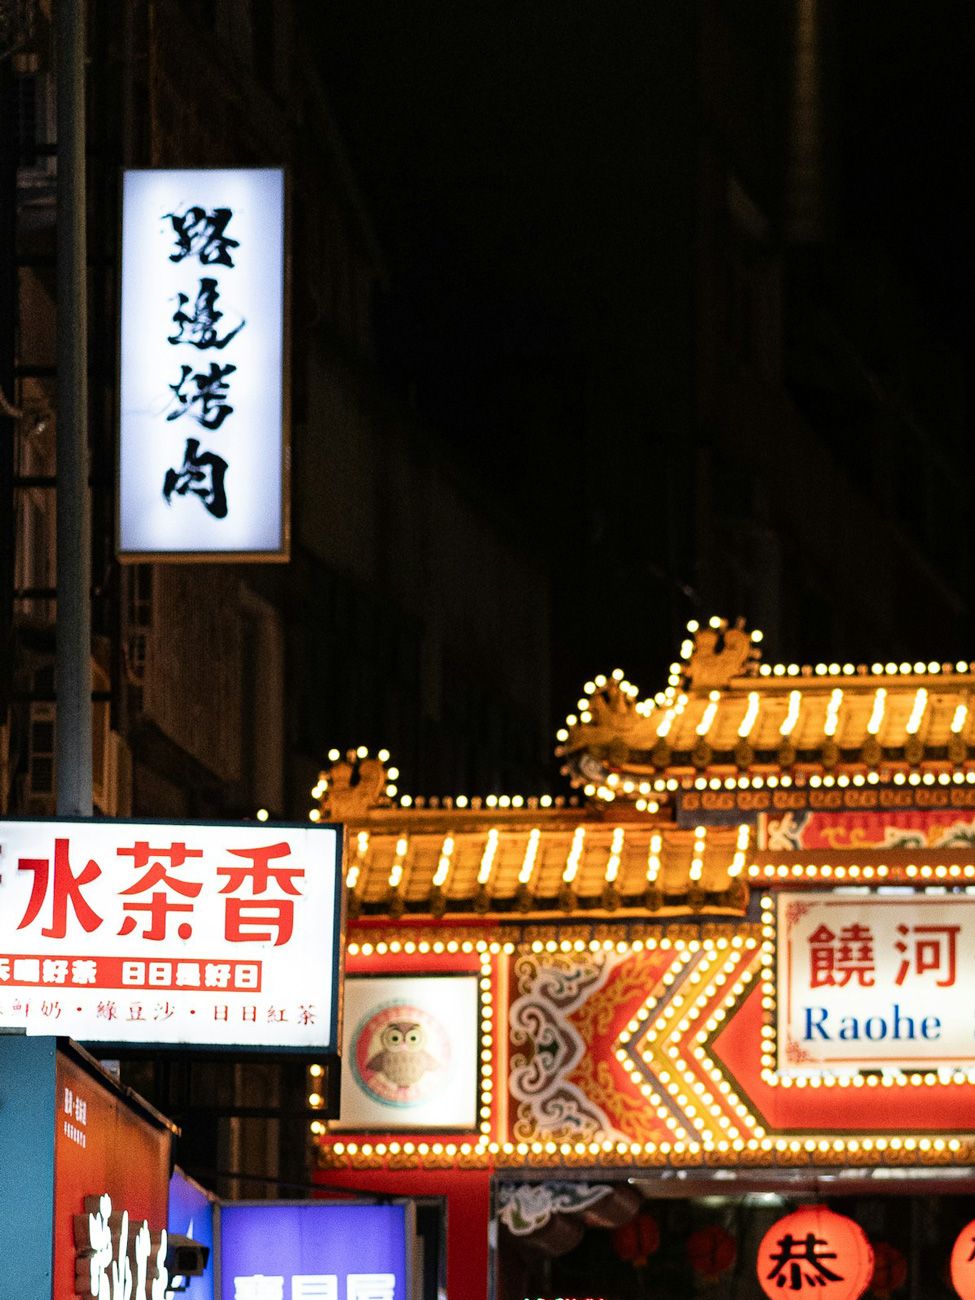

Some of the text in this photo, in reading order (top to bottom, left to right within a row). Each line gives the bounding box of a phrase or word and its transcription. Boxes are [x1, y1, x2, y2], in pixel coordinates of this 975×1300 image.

[0, 837, 305, 947] 水茶香
[803, 1003, 942, 1042] Raohe
[766, 1232, 845, 1291] 恭
